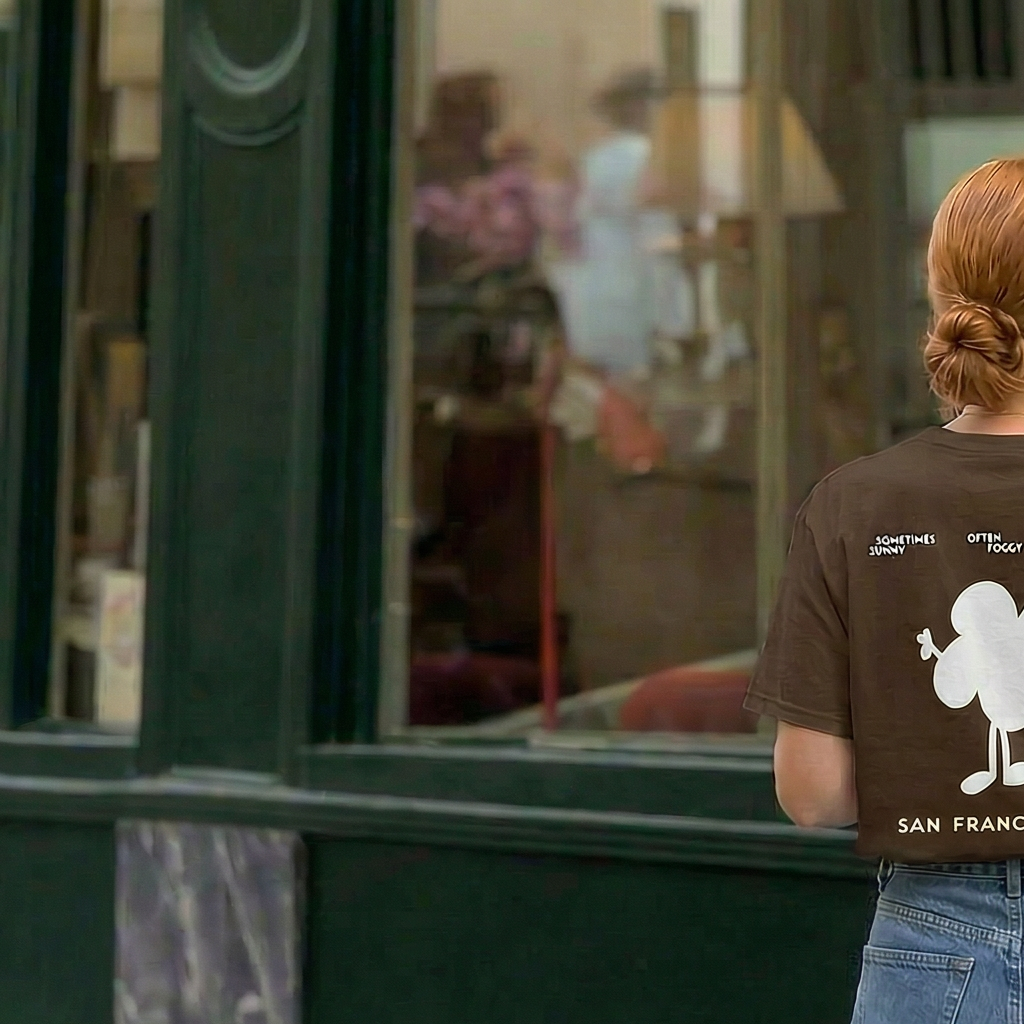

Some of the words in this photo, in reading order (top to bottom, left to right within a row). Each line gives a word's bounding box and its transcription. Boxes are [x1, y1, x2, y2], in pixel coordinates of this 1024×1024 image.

[875, 533, 936, 546] SOMETIMES
[967, 532, 1002, 543] OFTEN
[868, 545, 906, 556] SUNNY
[987, 542, 1023, 553] FOGGY
[898, 817, 939, 833] SAN
